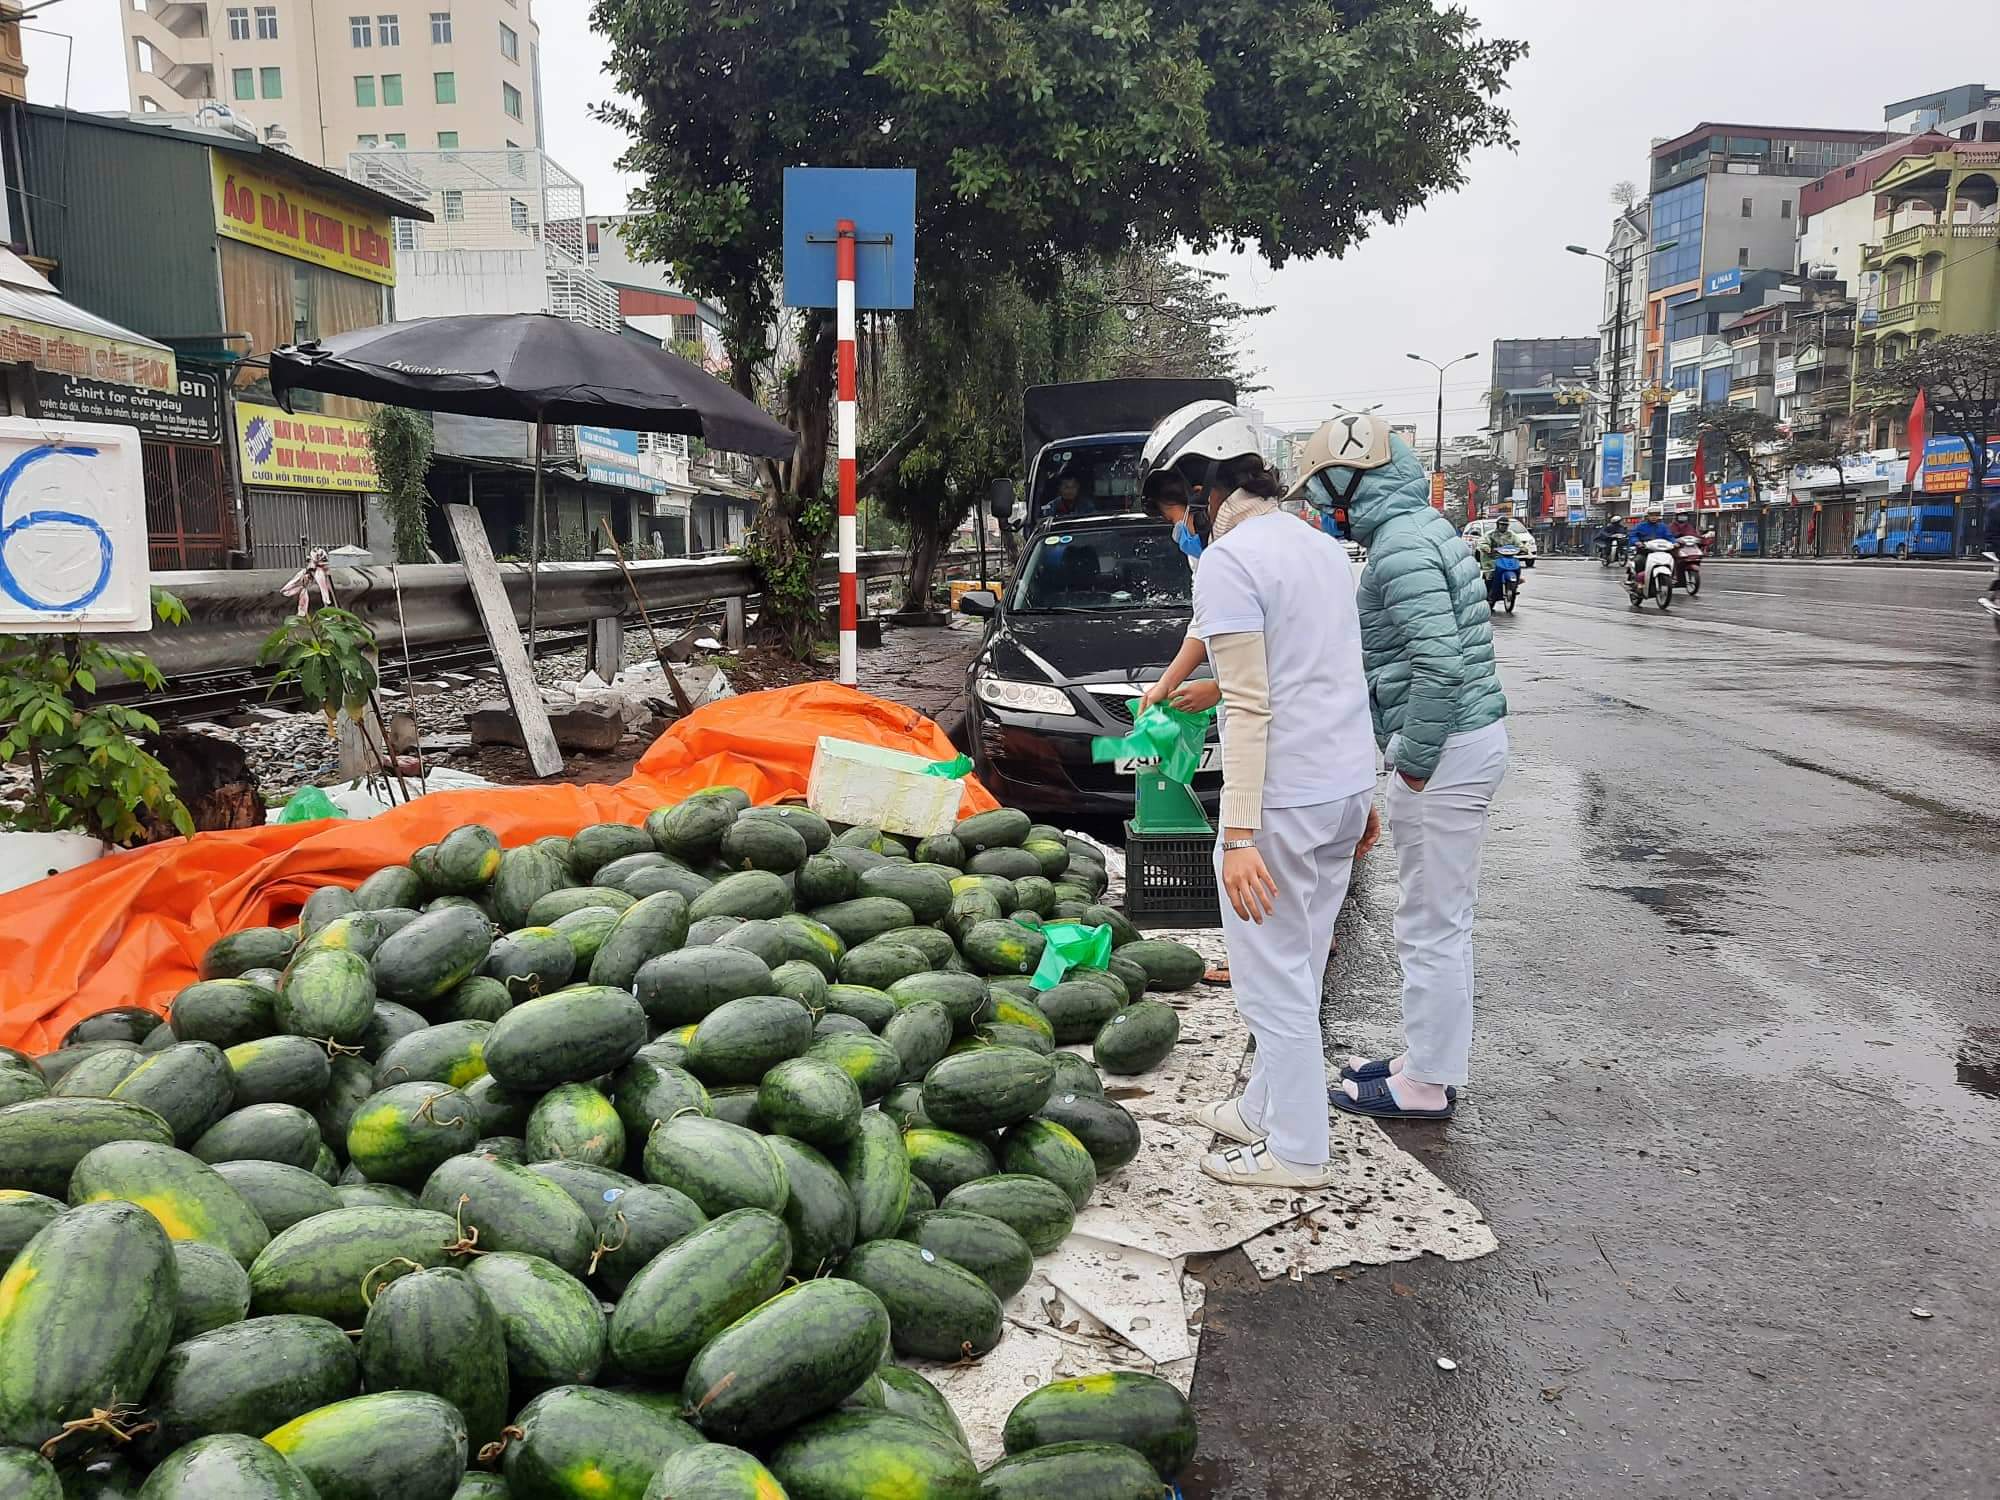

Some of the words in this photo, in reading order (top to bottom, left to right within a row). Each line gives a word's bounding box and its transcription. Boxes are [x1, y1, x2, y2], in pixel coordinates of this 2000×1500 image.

[223, 174, 256, 225] ÁO
[260, 192, 300, 240] DÀI
[303, 208, 345, 255] KIM
[348, 224, 391, 269] LIÊN
[64, 384, 105, 401] t-shirt
[108, 390, 127, 404] for
[130, 396, 183, 413] everyday
[180, 380, 207, 397] en
[336, 478, 353, 487] CHO
[0, 443, 113, 612] 6
